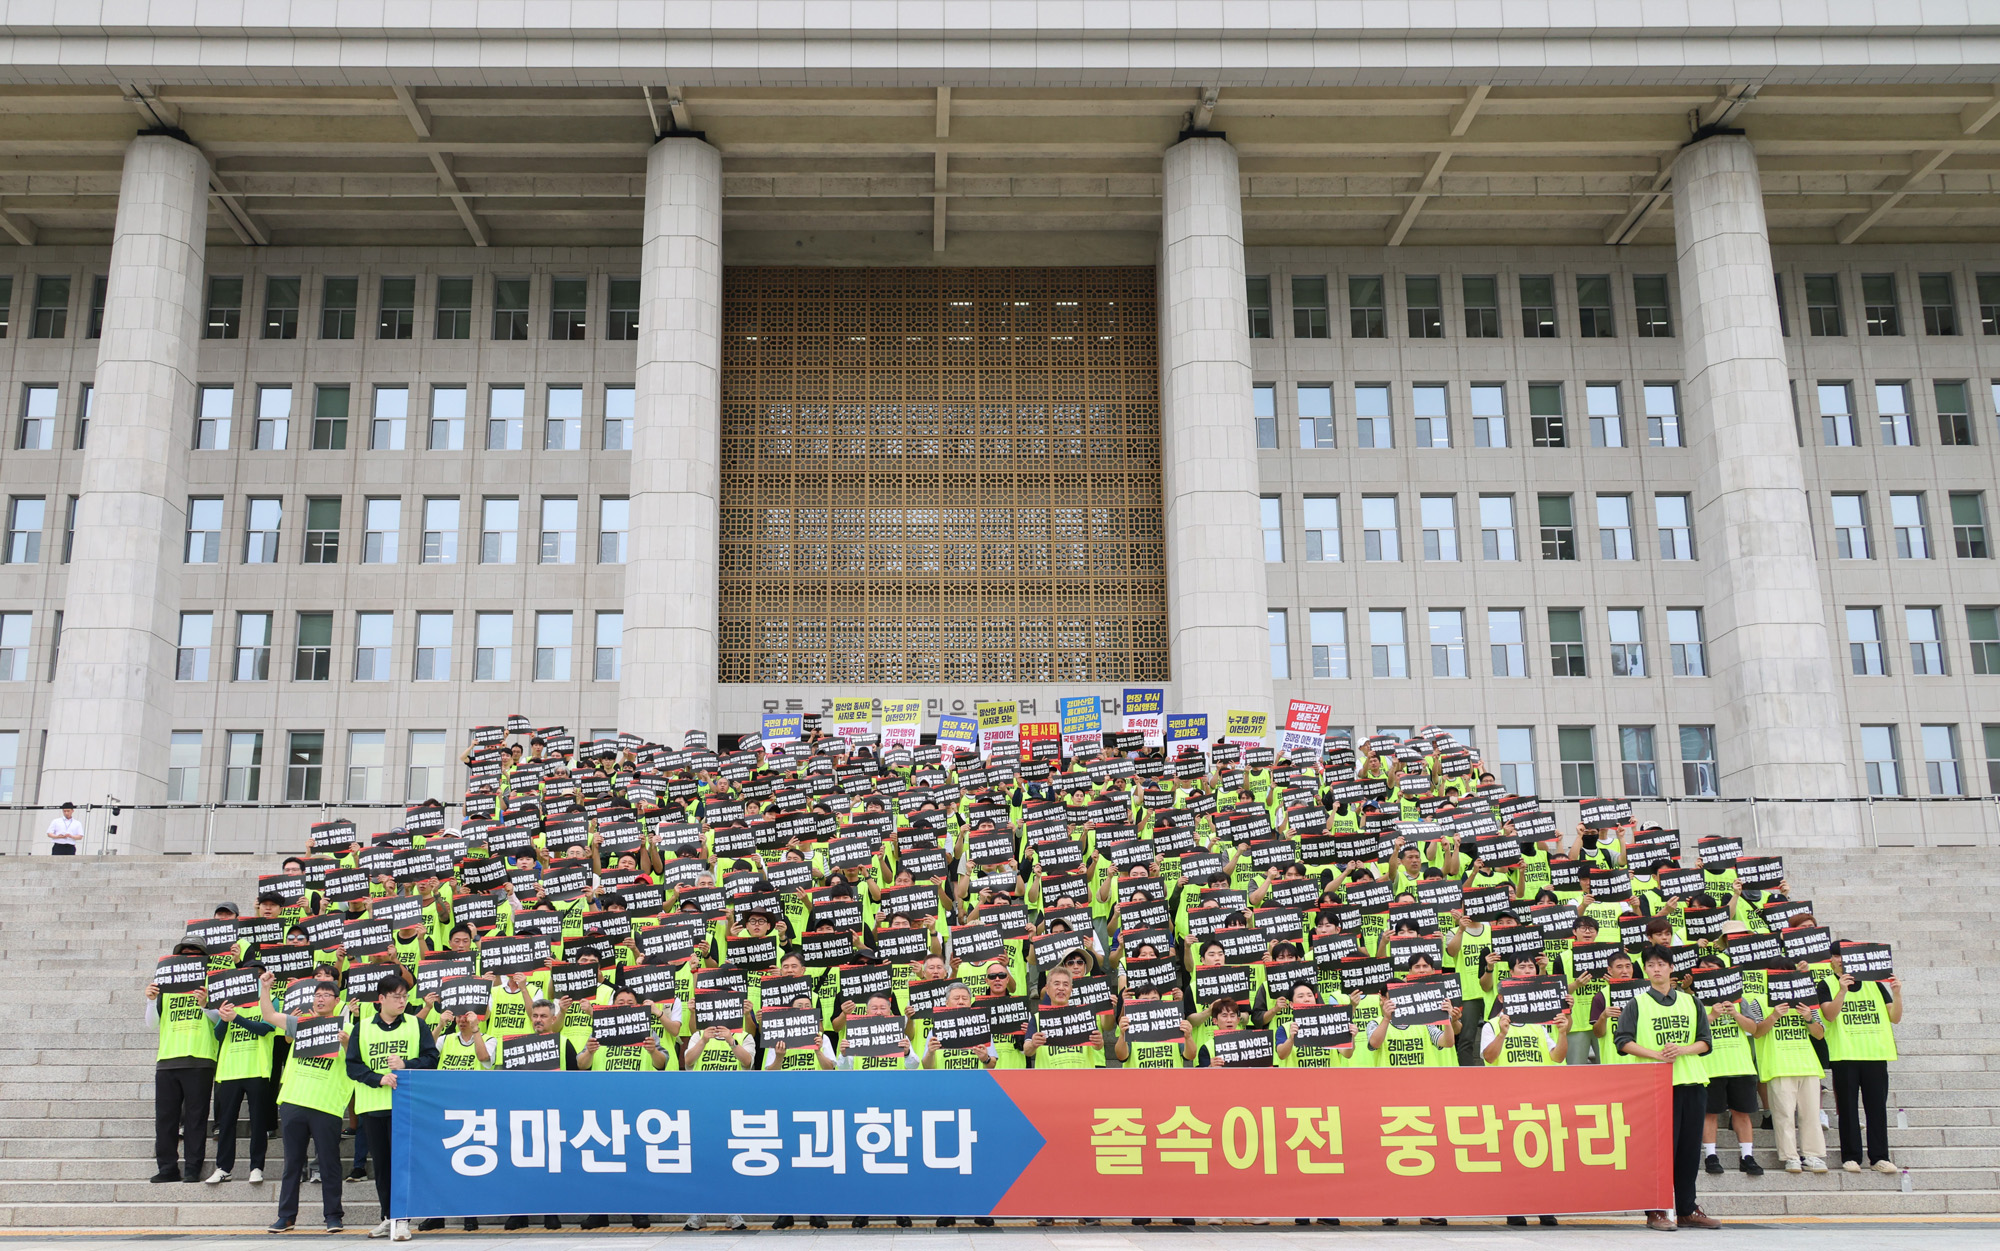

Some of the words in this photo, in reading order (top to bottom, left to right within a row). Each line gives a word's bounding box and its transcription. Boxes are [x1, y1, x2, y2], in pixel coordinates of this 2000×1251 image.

[1066, 697, 1094, 708] 경마산업
[1126, 694, 1142, 703] 현장
[1144, 693, 1160, 702] 무시
[836, 703, 852, 711] 말산업
[854, 702, 870, 710] 종사자
[884, 705, 904, 713] 누구를
[906, 703, 919, 711] 위한
[980, 708, 996, 717] 말산업
[998, 705, 1015, 714] 종사자
[1290, 702, 1329, 714] 마필관리사
[838, 712, 854, 720] 사지로
[856, 711, 867, 719] 모는
[885, 713, 916, 722] 이전인가?
[983, 717, 999, 725] 사지로
[1000, 715, 1012, 723] 모는
[1228, 716, 1249, 724] 누구를
[1252, 716, 1265, 724] 위한
[1296, 713, 1320, 722] 생존권
[942, 721, 958, 729] 현장
[960, 722, 976, 731] 무시
[1128, 718, 1158, 727] 졸속이전
[886, 728, 915, 737] 기만행위
[984, 731, 1014, 740] 강제이전
[1230, 725, 1262, 734] 이전인가?
[643, 936, 662, 945] 무대포
[665, 930, 692, 942] 마사이전,
[953, 937, 972, 946] 무대포
[974, 931, 1001, 942] 마사이전,
[1784, 939, 1804, 947] 무대포
[1805, 932, 1829, 944] 마사이전,
[482, 947, 499, 957] 무대포
[502, 941, 533, 953] 마사이전,
[645, 946, 663, 956] 경주마
[955, 945, 974, 955] 경주마
[1787, 948, 1806, 957] 경주마
[173, 962, 205, 972] 마사이전,
[482, 957, 500, 968] 경주마
[1342, 969, 1362, 977] 무대포
[1364, 963, 1392, 974] 마사이전,
[208, 981, 224, 992] 무대포
[225, 974, 257, 987] 마사이전,
[841, 977, 859, 986] 무대포
[861, 970, 890, 982] 마사이전,
[1197, 978, 1217, 986] 무대포
[1219, 973, 1248, 983] 마사이전,
[1343, 979, 1364, 987] 경주마
[210, 991, 225, 1002] 경주마
[842, 987, 861, 996] 경주마
[1199, 987, 1219, 996] 경주마
[1504, 995, 1527, 1004] 무대포
[1529, 989, 1559, 1001] 마사이전,
[495, 1003, 526, 1015] 경마공원
[696, 1001, 712, 1011] 무대포
[715, 997, 742, 1008] 마사이전,
[1506, 1005, 1530, 1015] 경주마
[1841, 1000, 1876, 1011] 경마공원
[170, 1009, 203, 1021] 이전반대
[697, 1012, 713, 1021] 경주마
[1149, 1007, 1181, 1018] 마사이전,
[1843, 1012, 1880, 1025] 이전반대
[494, 1016, 525, 1029] 이전반대
[594, 1017, 615, 1027] 무대포
[617, 1011, 649, 1024] 마사이전,
[762, 1018, 784, 1028] 무대포
[786, 1013, 817, 1025] 마사이전,
[1651, 1015, 1689, 1030] 경마공원
[595, 1027, 616, 1038] 경주마
[618, 1022, 650, 1034] 사형선고!
[763, 1029, 785, 1040] 경주마
[787, 1025, 818, 1037] 사형선고!
[847, 1026, 868, 1036] 무대포
[870, 1022, 902, 1035] 마사이전,
[369, 1040, 408, 1056] 경마공원
[504, 1048, 524, 1057] 무대포
[526, 1038, 558, 1052] 마사이전,
[1387, 1039, 1423, 1051] 경마공원
[1504, 1036, 1539, 1049] 경마공원
[1138, 1045, 1172, 1059] 경마공원
[1507, 1050, 1542, 1063] 이전반대
[505, 1058, 525, 1068] 경주마
[527, 1049, 559, 1063] 사형선고!
[606, 1057, 641, 1071] 이전반대
[782, 1053, 814, 1068] 경마공원
[862, 1057, 897, 1069] 경마공원
[1389, 1053, 1424, 1066] 이전반대
[441, 1107, 692, 1177] 경마산업
[728, 1106, 978, 1177] 붕괴한다
[1089, 1104, 1346, 1177] 졸속이전
[1379, 1102, 1632, 1177] 중단하라
